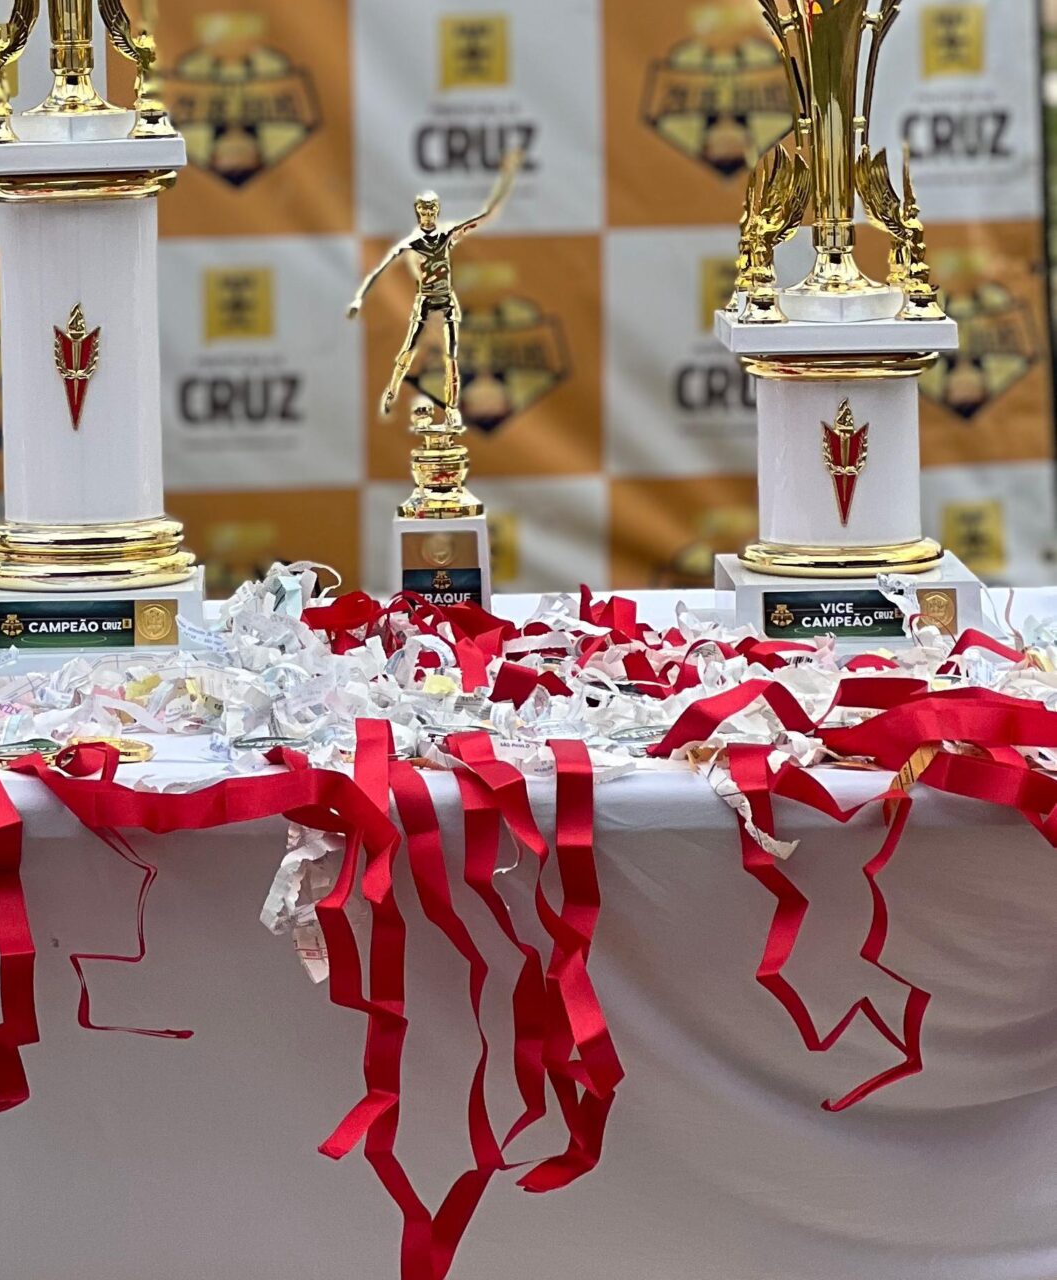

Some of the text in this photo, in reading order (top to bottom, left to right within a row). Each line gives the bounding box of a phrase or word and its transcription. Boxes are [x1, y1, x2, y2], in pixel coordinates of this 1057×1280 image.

[900, 109, 1012, 160] CRUZ
[413, 122, 539, 176] CRUZ
[675, 365, 757, 413] CRU
[177, 373, 303, 427] CRUZ
[420, 592, 471, 604] RAQUE
[820, 602, 854, 614] VICE
[874, 610, 894, 620] CRUZ
[28, 618, 99, 633] CAMPEÃO
[102, 621, 122, 631] CRUZ
[802, 613, 873, 628] CAMPEÃO
